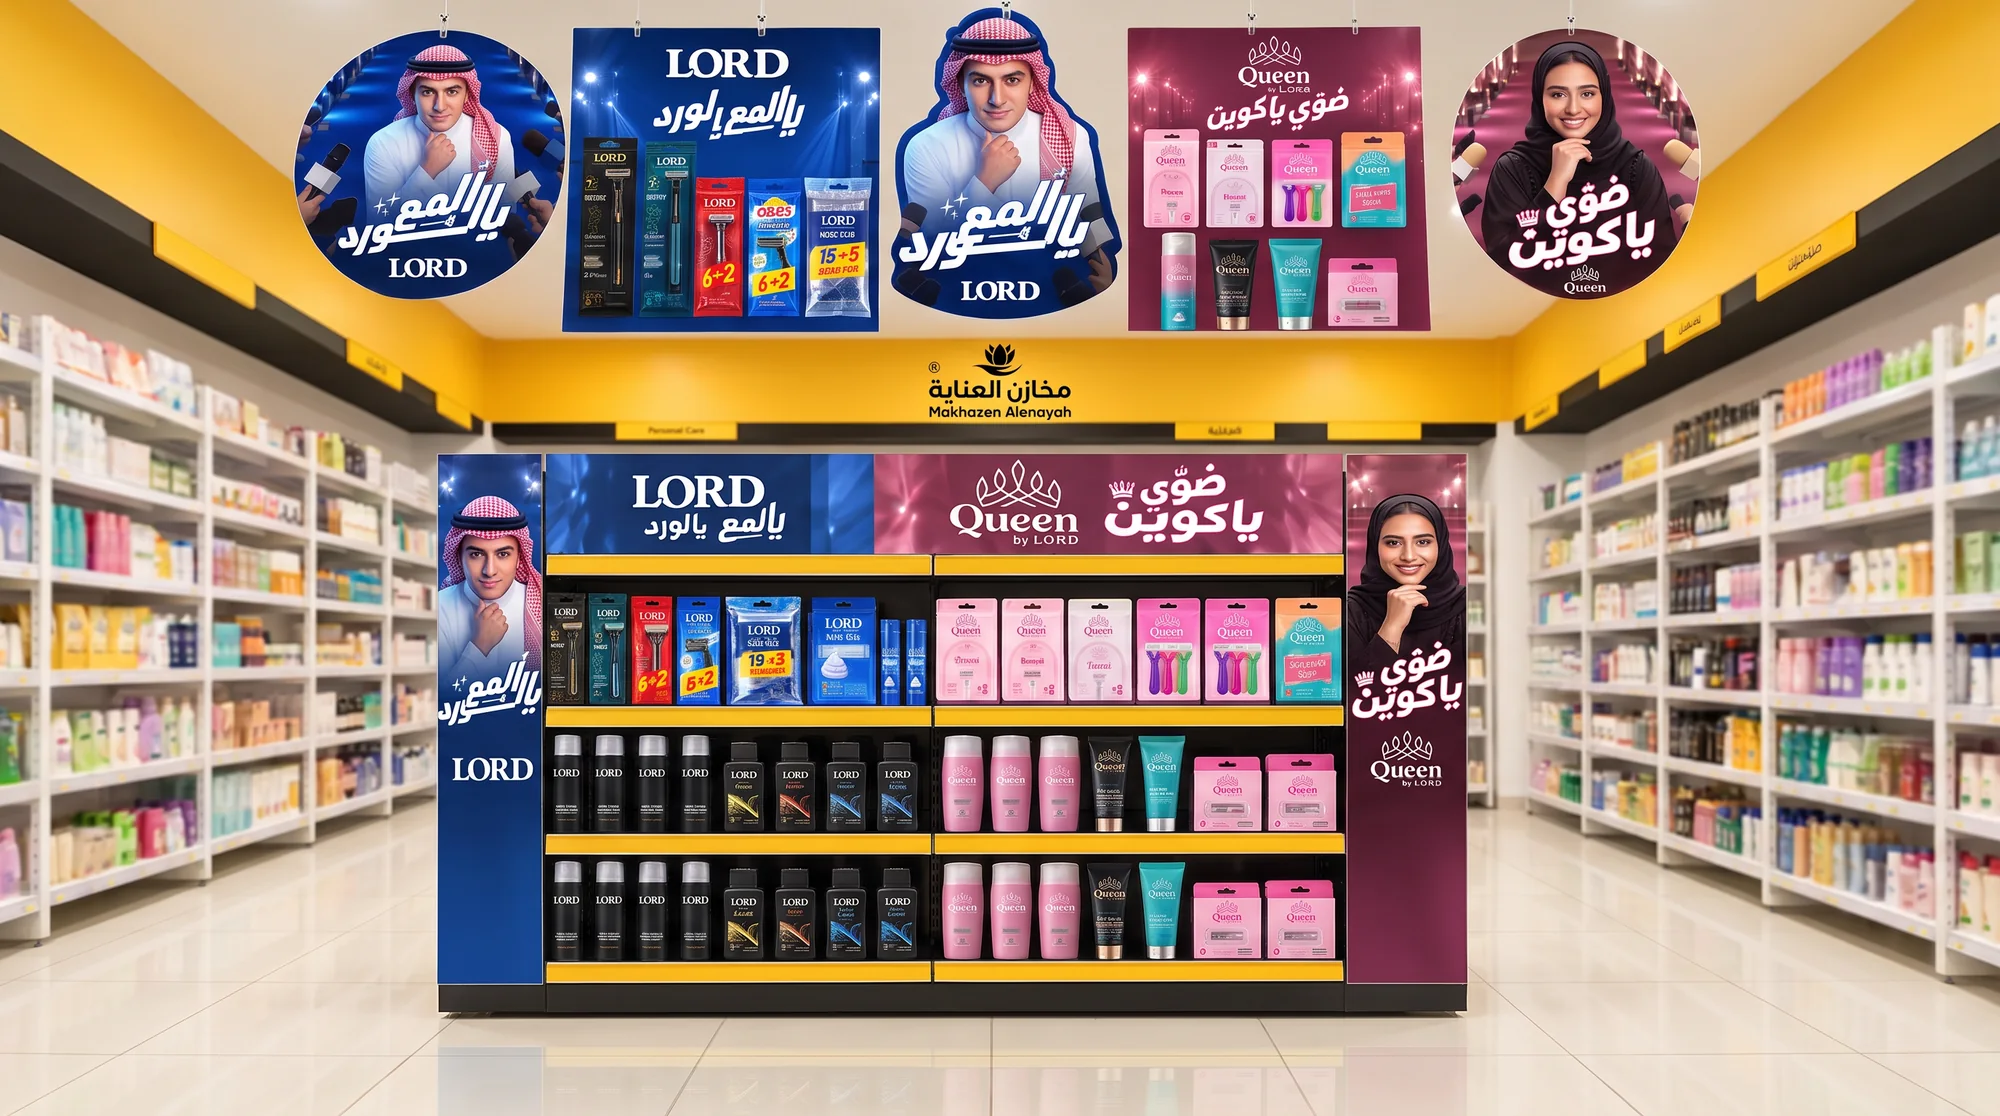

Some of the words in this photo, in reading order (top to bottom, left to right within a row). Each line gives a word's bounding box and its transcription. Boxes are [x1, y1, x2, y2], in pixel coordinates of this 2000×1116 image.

[666, 48, 789, 78] LORD
[1238, 66, 1310, 88] Queen
[594, 154, 626, 162] LORD
[657, 157, 687, 166] LORD
[1156, 156, 1185, 165] Queen
[1355, 165, 1390, 175] Queen
[704, 199, 736, 207] LORD
[821, 215, 856, 226] LORD
[388, 258, 468, 278] LORD
[961, 281, 1041, 301] LORD
[1347, 285, 1378, 293] Queen
[1563, 282, 1607, 294] Queen
[928, 379, 1001, 404] العناية
[1007, 379, 1072, 404] مخازن
[928, 406, 1001, 418] Makhazen
[1005, 406, 1072, 420] Alenayah
[632, 475, 765, 509] LORD
[949, 504, 1079, 539] Queen
[1013, 535, 1028, 547] by
[1034, 535, 1079, 545] LORD
[554, 608, 578, 616] LORD
[597, 609, 620, 617] LORD
[640, 612, 666, 620] LORD
[685, 613, 713, 622] LORD
[825, 618, 862, 629] LORD
[748, 626, 780, 635] LORD
[951, 626, 981, 638] Queen
[1150, 627, 1184, 639] Queen
[1217, 627, 1253, 639] Queen
[1290, 632, 1325, 645] Queen
[452, 757, 534, 781] LORD
[553, 769, 580, 777] LORD
[595, 769, 623, 777] LORD
[638, 769, 666, 777] LORD
[682, 769, 709, 777] LORD
[1370, 760, 1443, 783] Queen
[731, 771, 757, 779] LORD
[783, 771, 809, 779] LORD
[833, 771, 860, 779] LORD
[885, 771, 911, 779] LORD
[553, 896, 580, 904] LORD
[596, 896, 623, 904] LORD
[639, 896, 665, 904] LORD
[682, 896, 709, 904] LORD
[731, 898, 757, 906] LORD
[783, 898, 809, 906] LORD
[833, 898, 860, 906] LORD
[885, 898, 911, 906] LORD
